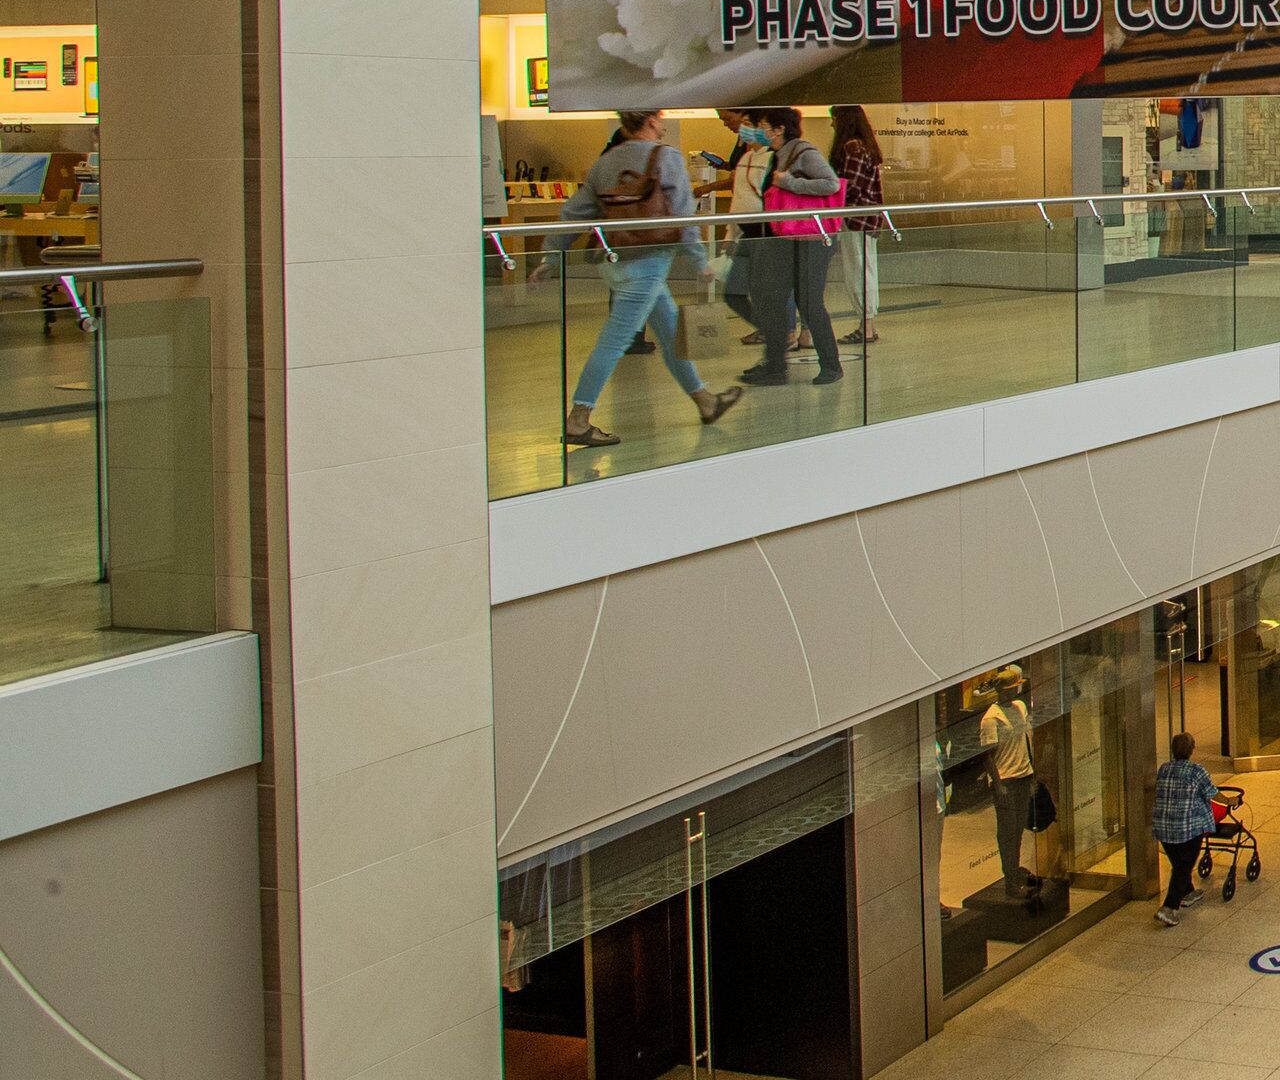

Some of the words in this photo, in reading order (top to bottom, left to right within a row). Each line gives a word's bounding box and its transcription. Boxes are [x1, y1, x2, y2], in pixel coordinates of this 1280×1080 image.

[896, 117, 907, 126] Buy
[932, 117, 945, 125] iPad
[878, 128, 906, 138] university
